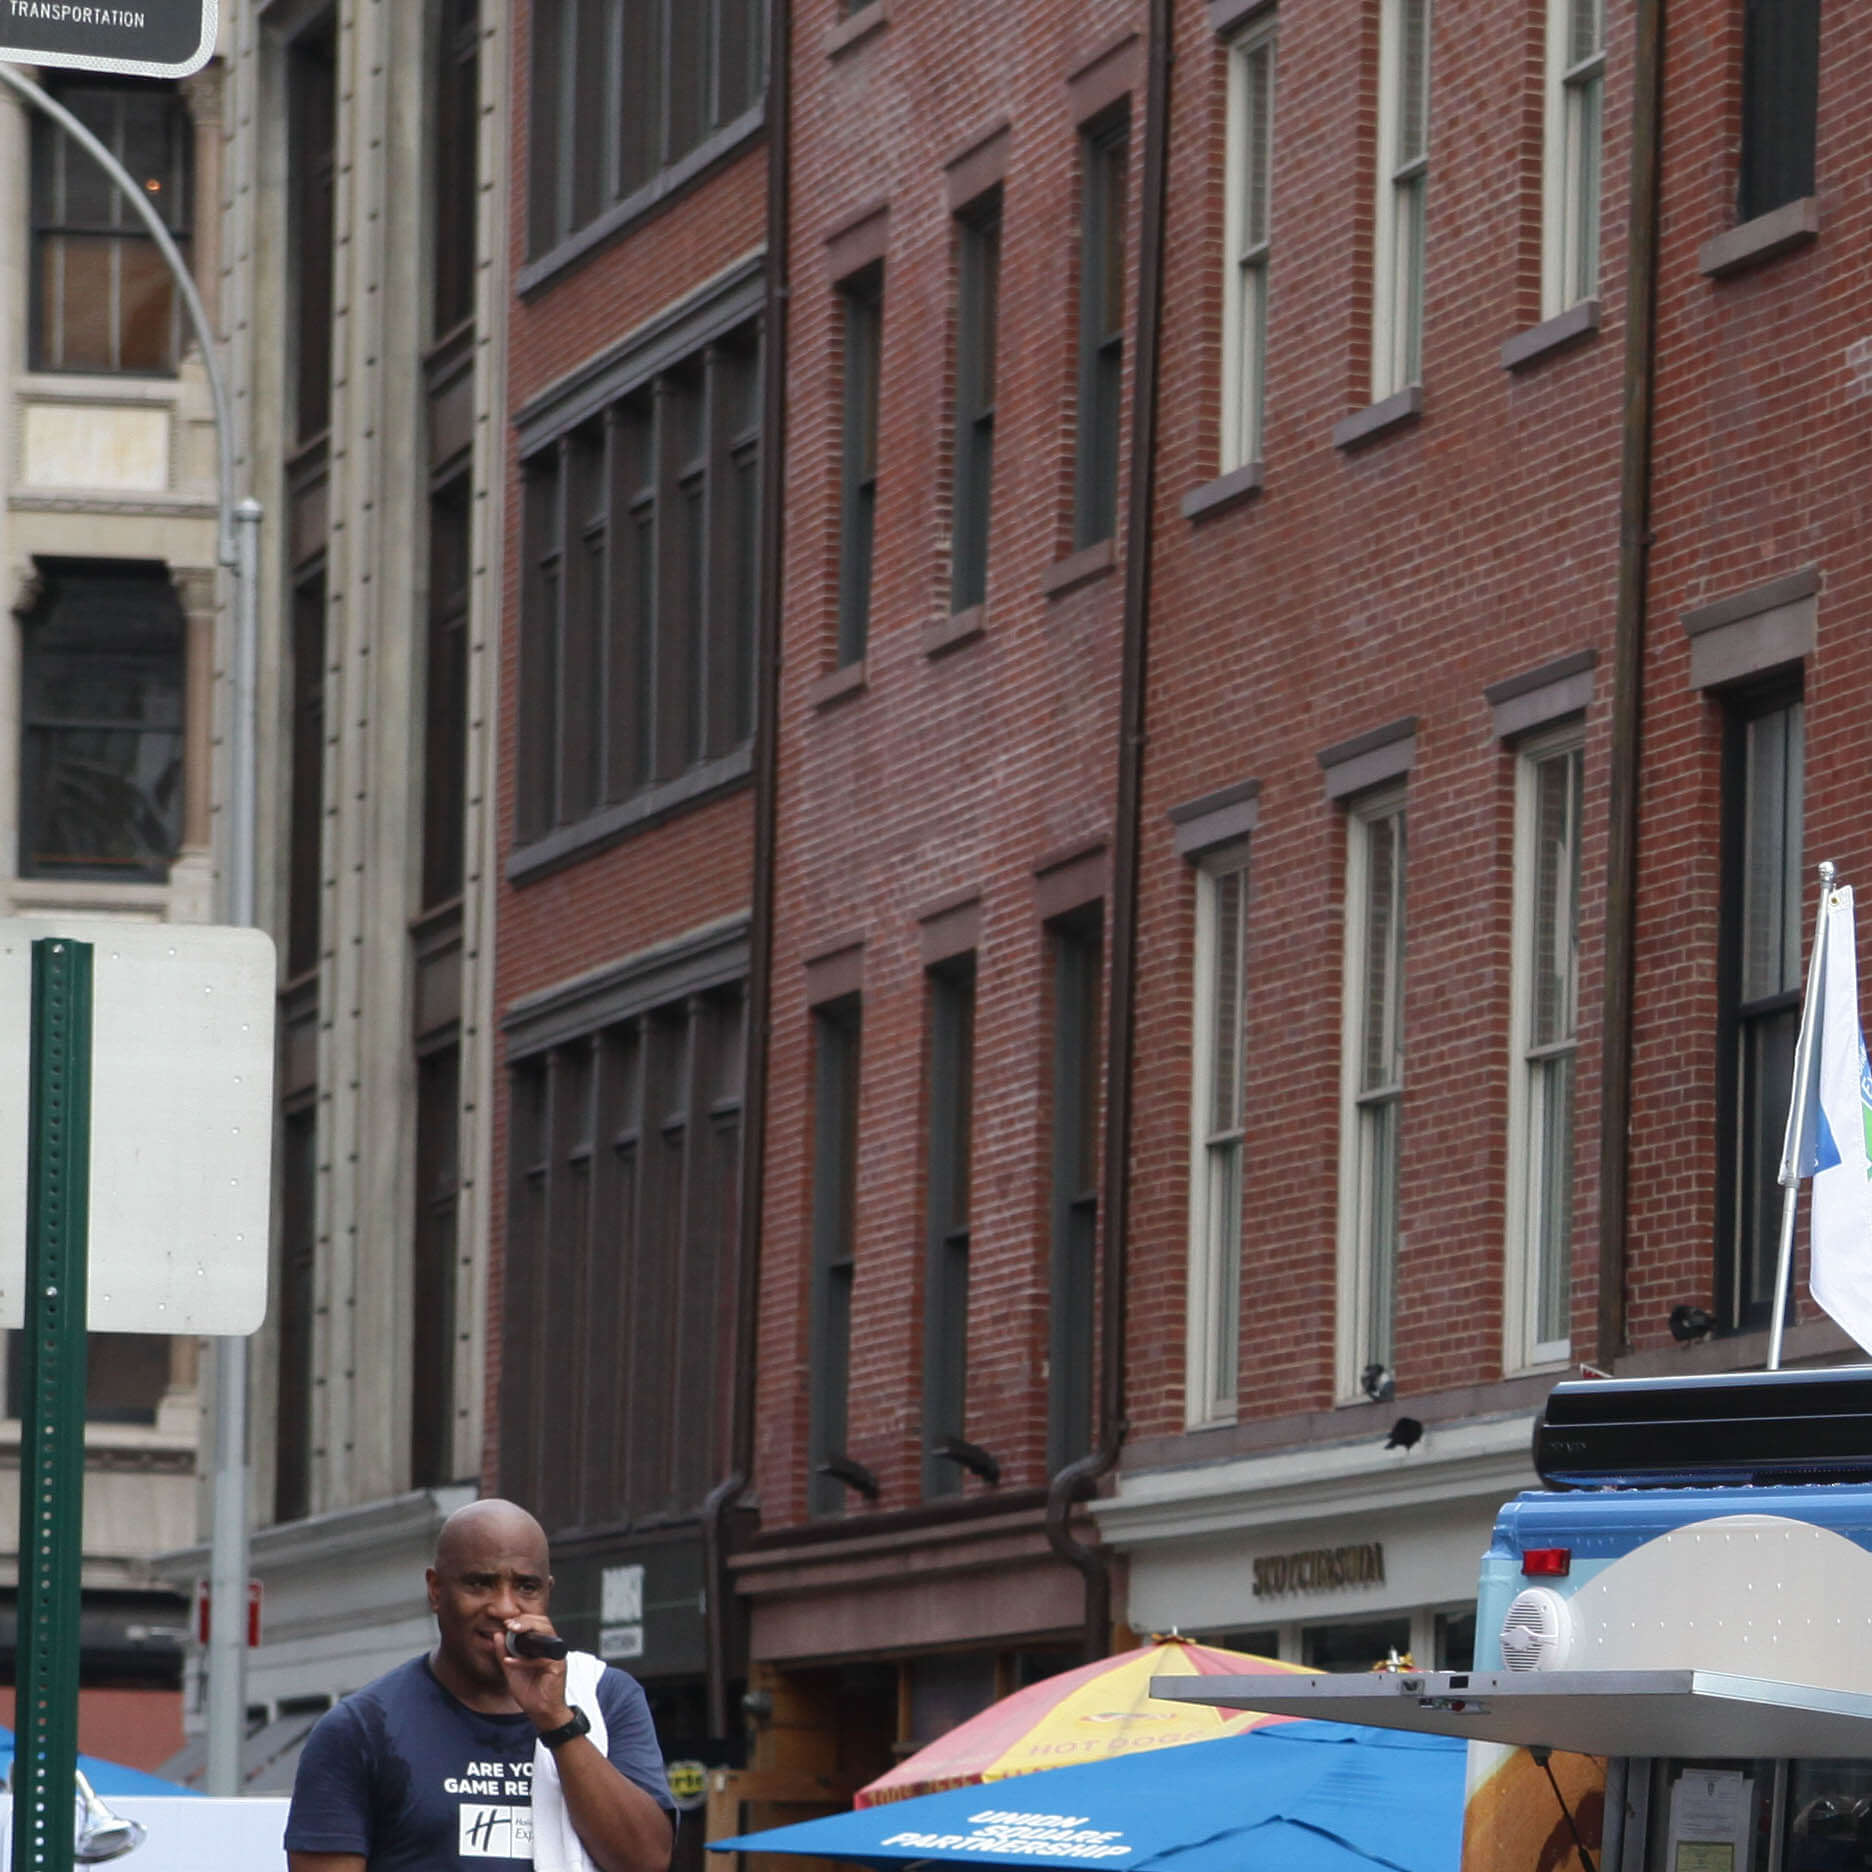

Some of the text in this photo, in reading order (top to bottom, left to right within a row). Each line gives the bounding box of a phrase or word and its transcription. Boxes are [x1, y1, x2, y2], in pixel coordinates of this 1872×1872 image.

[9, 0, 145, 28] TRANSPORTATION
[466, 1761, 534, 1778] ARE YO
[443, 1778, 500, 1796] GAME
[967, 1810, 1091, 1828] UNION
[972, 1825, 1124, 1844] SQUARE
[881, 1832, 1133, 1859] PARTNERSHIP
